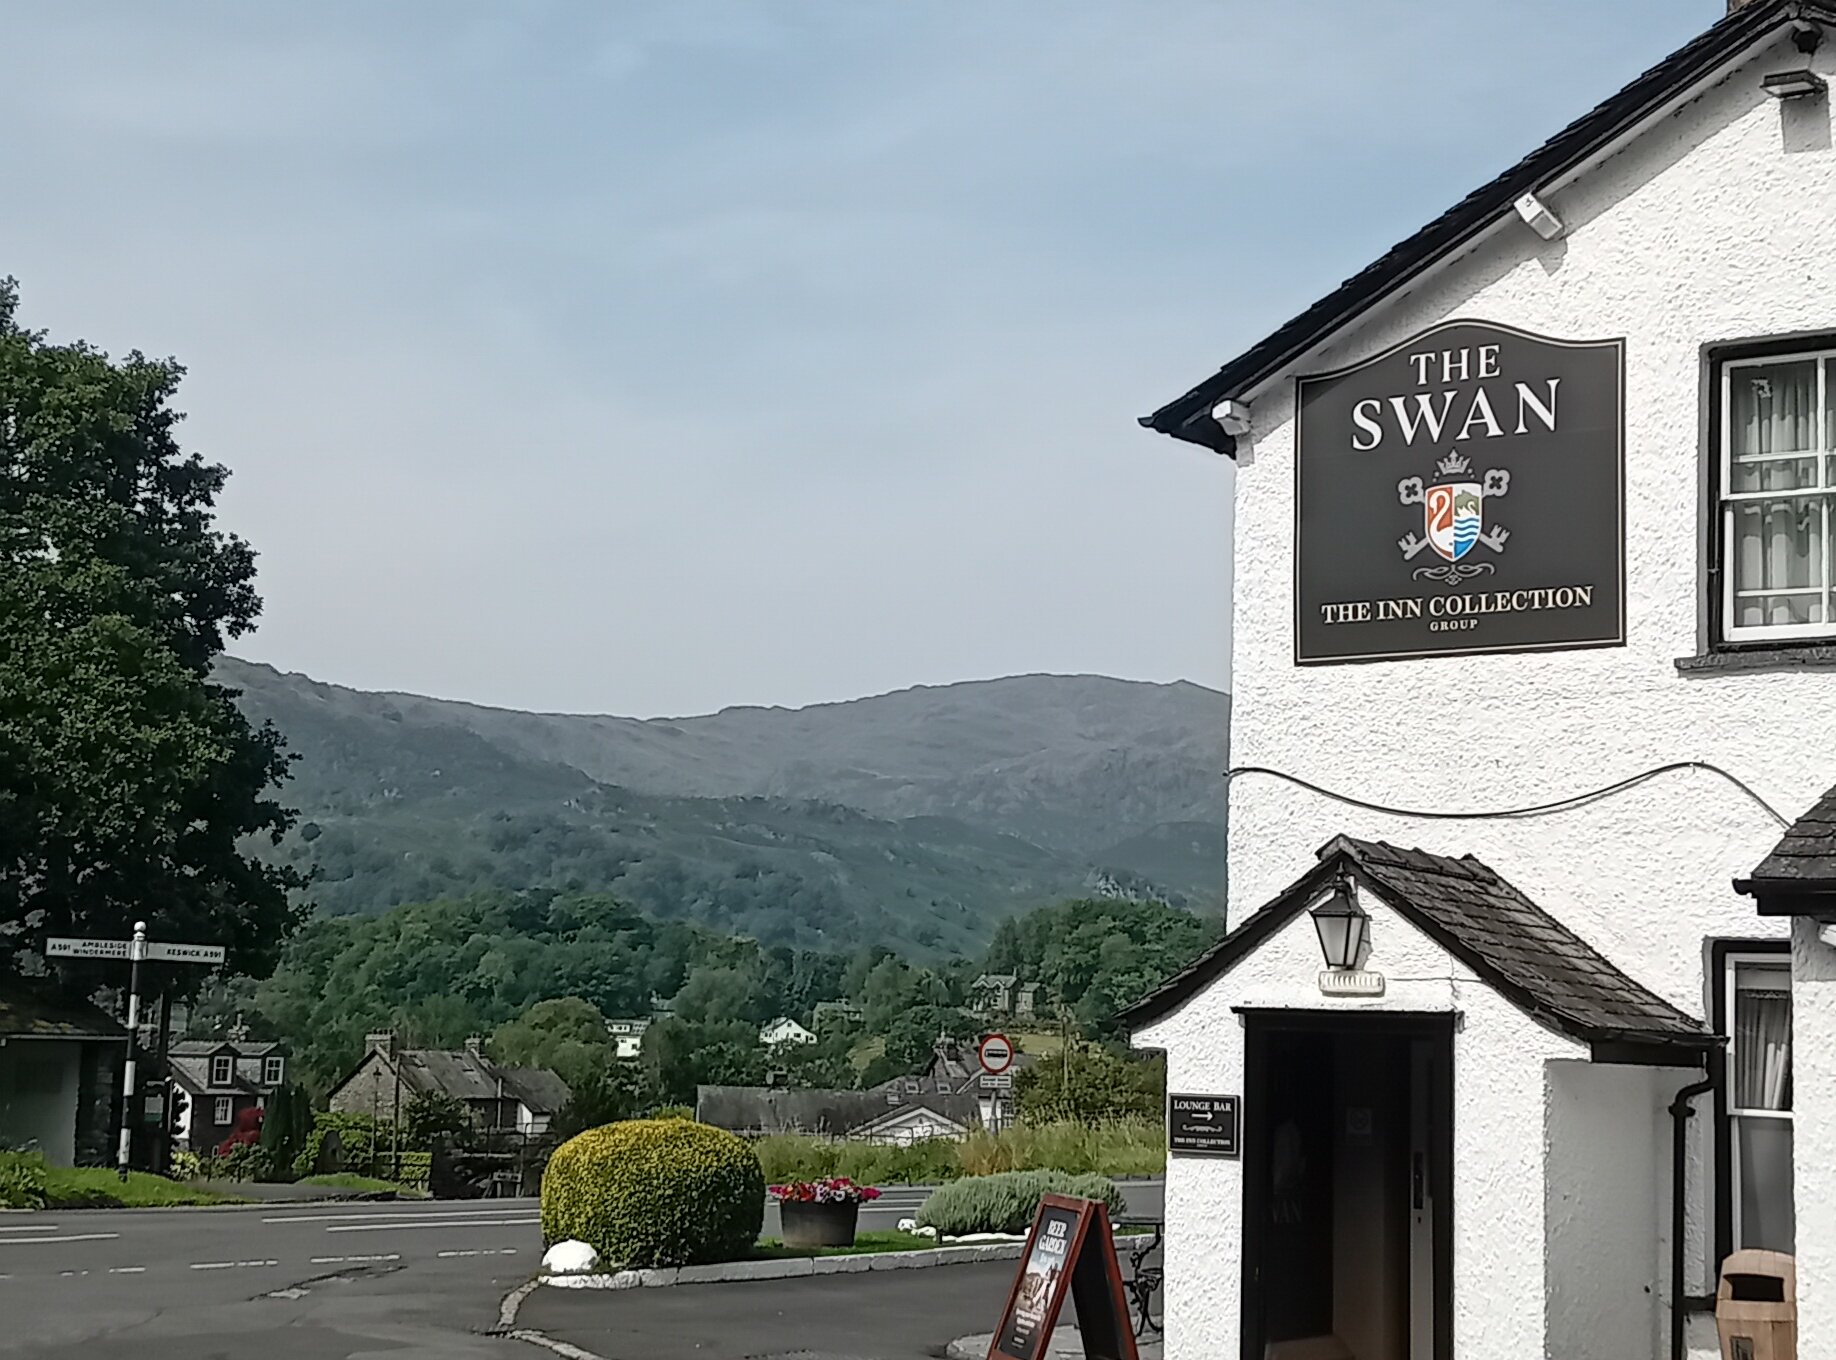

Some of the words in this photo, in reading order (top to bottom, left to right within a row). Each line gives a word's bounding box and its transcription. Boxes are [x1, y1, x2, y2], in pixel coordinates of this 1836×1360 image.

[1409, 344, 1501, 385] THE
[1351, 377, 1561, 451] SWAN
[1320, 601, 1371, 624] THE
[1376, 598, 1423, 620] INN
[1428, 585, 1594, 617] COLLECTION
[1429, 618, 1479, 632] GROUP
[51, 943, 71, 951] A591
[82, 941, 127, 949] AMBLESIDE
[73, 948, 126, 957] WINDERMERE
[167, 948, 200, 957] KESWICK
[203, 950, 222, 958] A591
[1174, 1100, 1210, 1110] LOUNGE
[1213, 1101, 1231, 1111] BAR
[1047, 1220, 1067, 1237] BEER
[1038, 1235, 1067, 1255] GARDEN
